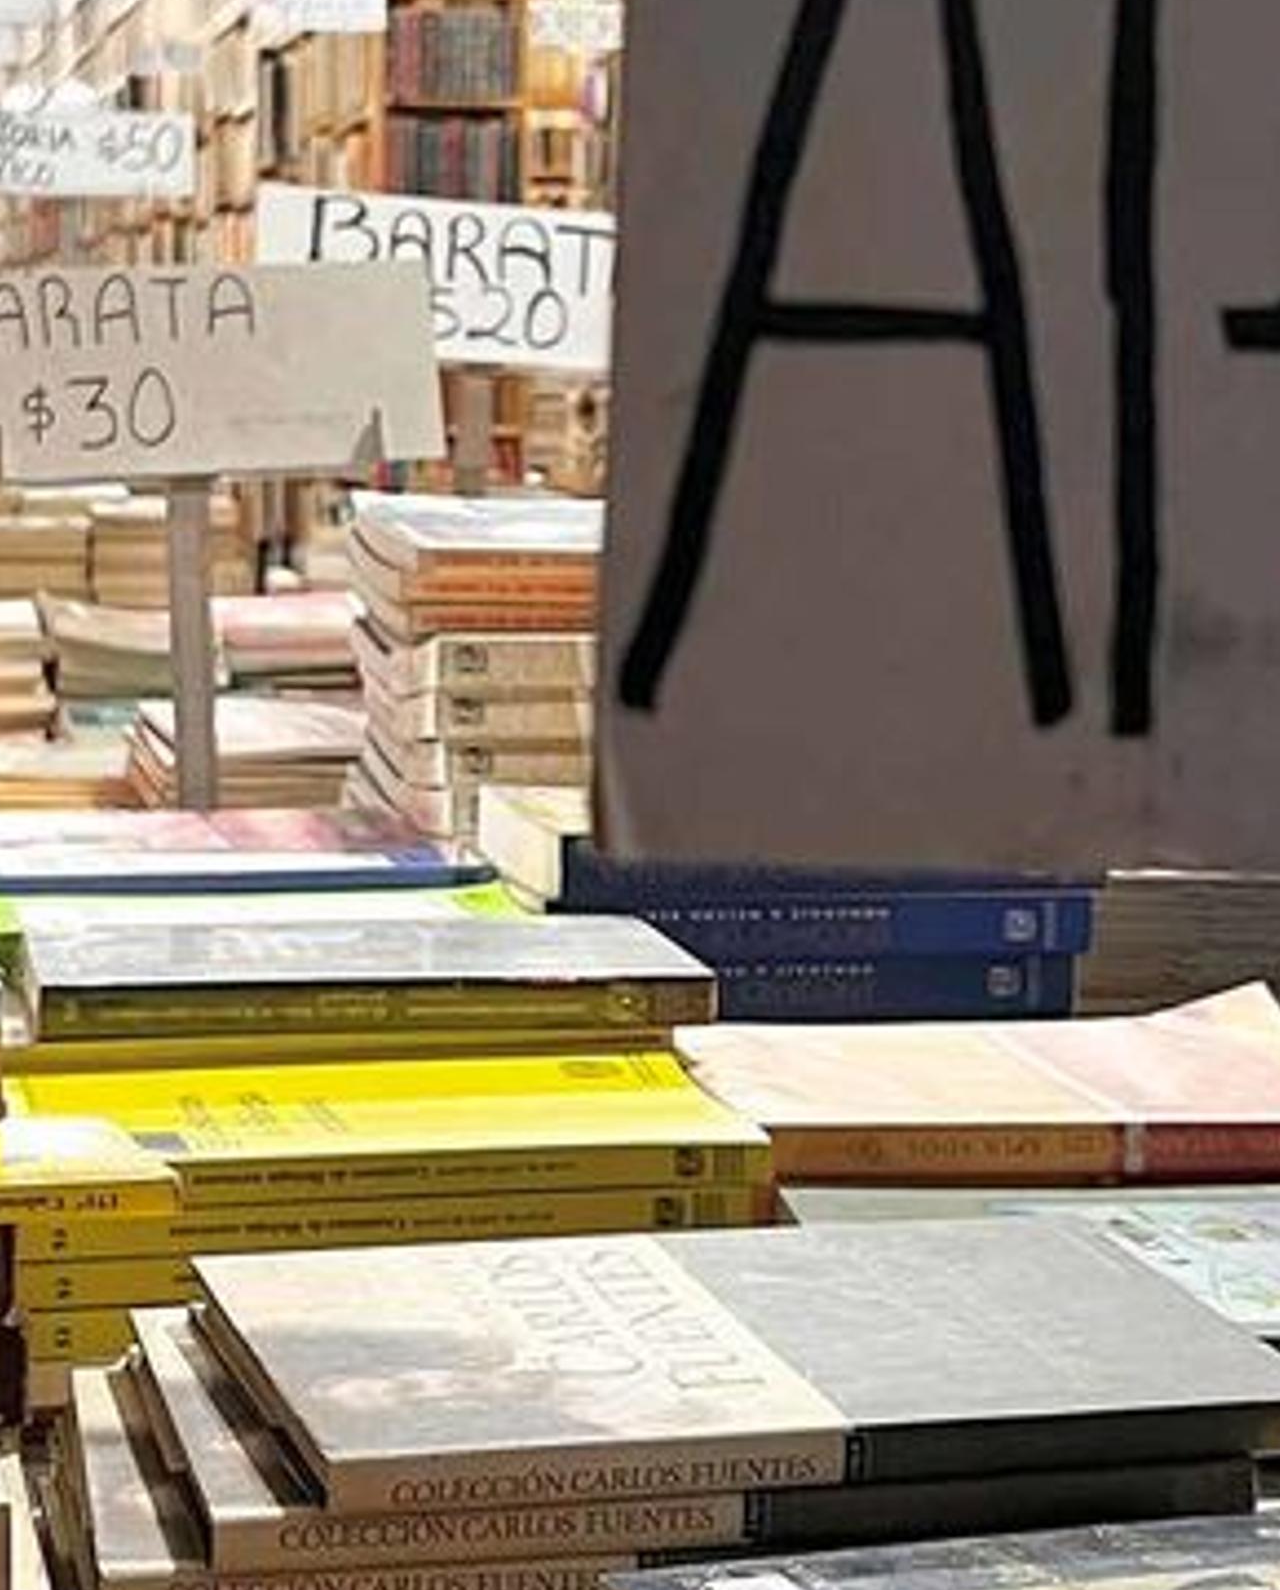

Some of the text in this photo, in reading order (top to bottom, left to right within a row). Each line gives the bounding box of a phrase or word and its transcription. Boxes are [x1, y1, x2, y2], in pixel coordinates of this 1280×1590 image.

[22, 366, 177, 452] $30
[390, 1454, 819, 1508] COLECCIÓN CARLOS FUENTES
[460, 1511, 579, 1546] CARLOS
[583, 1505, 715, 1537] FUENTES
